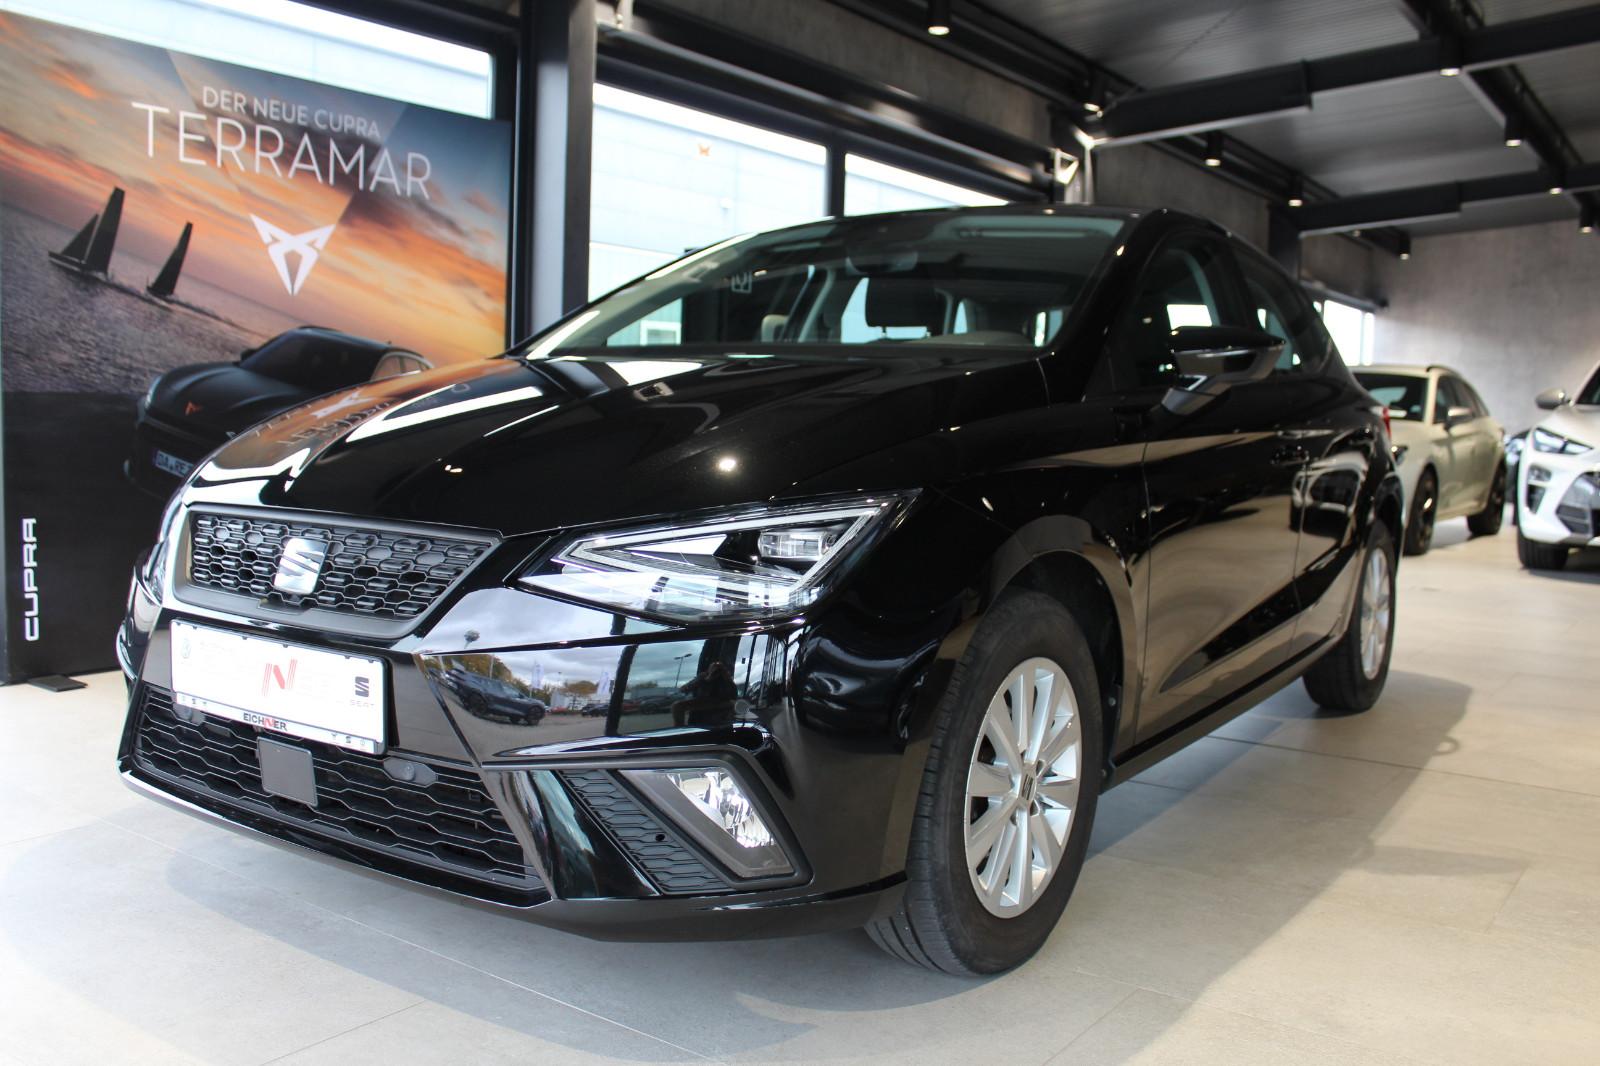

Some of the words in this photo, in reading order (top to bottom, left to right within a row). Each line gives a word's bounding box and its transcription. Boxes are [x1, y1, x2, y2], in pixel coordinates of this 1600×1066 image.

[203, 86, 247, 114] DER
[253, 97, 308, 126] NEUE
[314, 109, 381, 138] CUPRA
[131, 101, 431, 200] TERRAMAR
[22, 518, 40, 641] CUPRA
[243, 712, 288, 731] EICHNER
